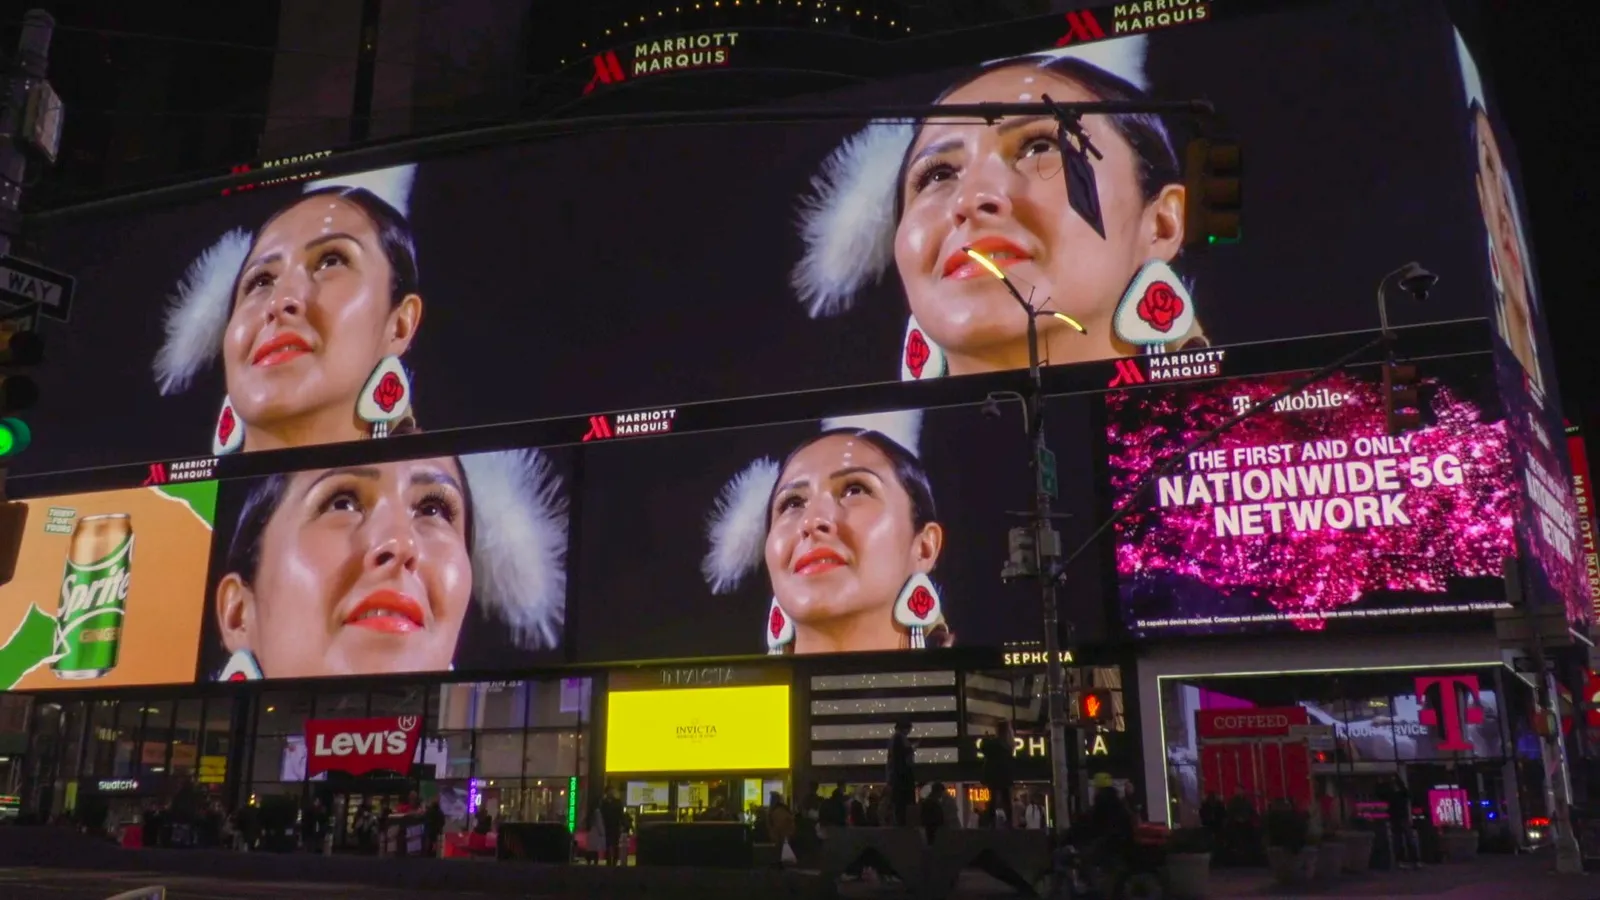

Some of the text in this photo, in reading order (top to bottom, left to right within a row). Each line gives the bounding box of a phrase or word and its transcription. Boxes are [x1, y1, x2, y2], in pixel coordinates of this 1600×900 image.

[1114, 0, 1213, 17] MARRIO
[1115, 7, 1206, 33] MARQUIS
[635, 33, 739, 57] MARRIOTT
[634, 50, 725, 75] MARQUIS
[8, 270, 53, 300] WAY
[1150, 351, 1225, 367] MARRIOTT
[1151, 364, 1217, 380] MARQUIS
[617, 409, 677, 424] MARRIOTT
[616, 421, 669, 434] MARQUIS
[1188, 434, 1413, 470] THE FIRST AND ONLY
[170, 469, 212, 481] MARQUIS
[171, 459, 219, 470] MARRIOTT
[1158, 453, 1463, 507] NATIONWIDE 5G
[1214, 493, 1411, 537] NETWORK
[1573, 475, 1594, 550] MARRIOTT
[57, 564, 131, 622] Sprite
[1137, 619, 1146, 627] 5G
[1147, 618, 1168, 627] capable
[1169, 617, 1187, 625] device
[1188, 616, 1212, 625] required.
[1214, 615, 1240, 623] Coverage
[1252, 613, 1277, 621] available
[1353, 610, 1366, 618] may
[1366, 608, 1388, 616] require
[1389, 607, 1410, 615] certain
[1411, 606, 1425, 615] plan
[661, 667, 733, 684] INVICTA
[1213, 714, 1288, 730] COFFEED
[1415, 675, 1484, 750] T
[676, 725, 717, 735] INVICTA
